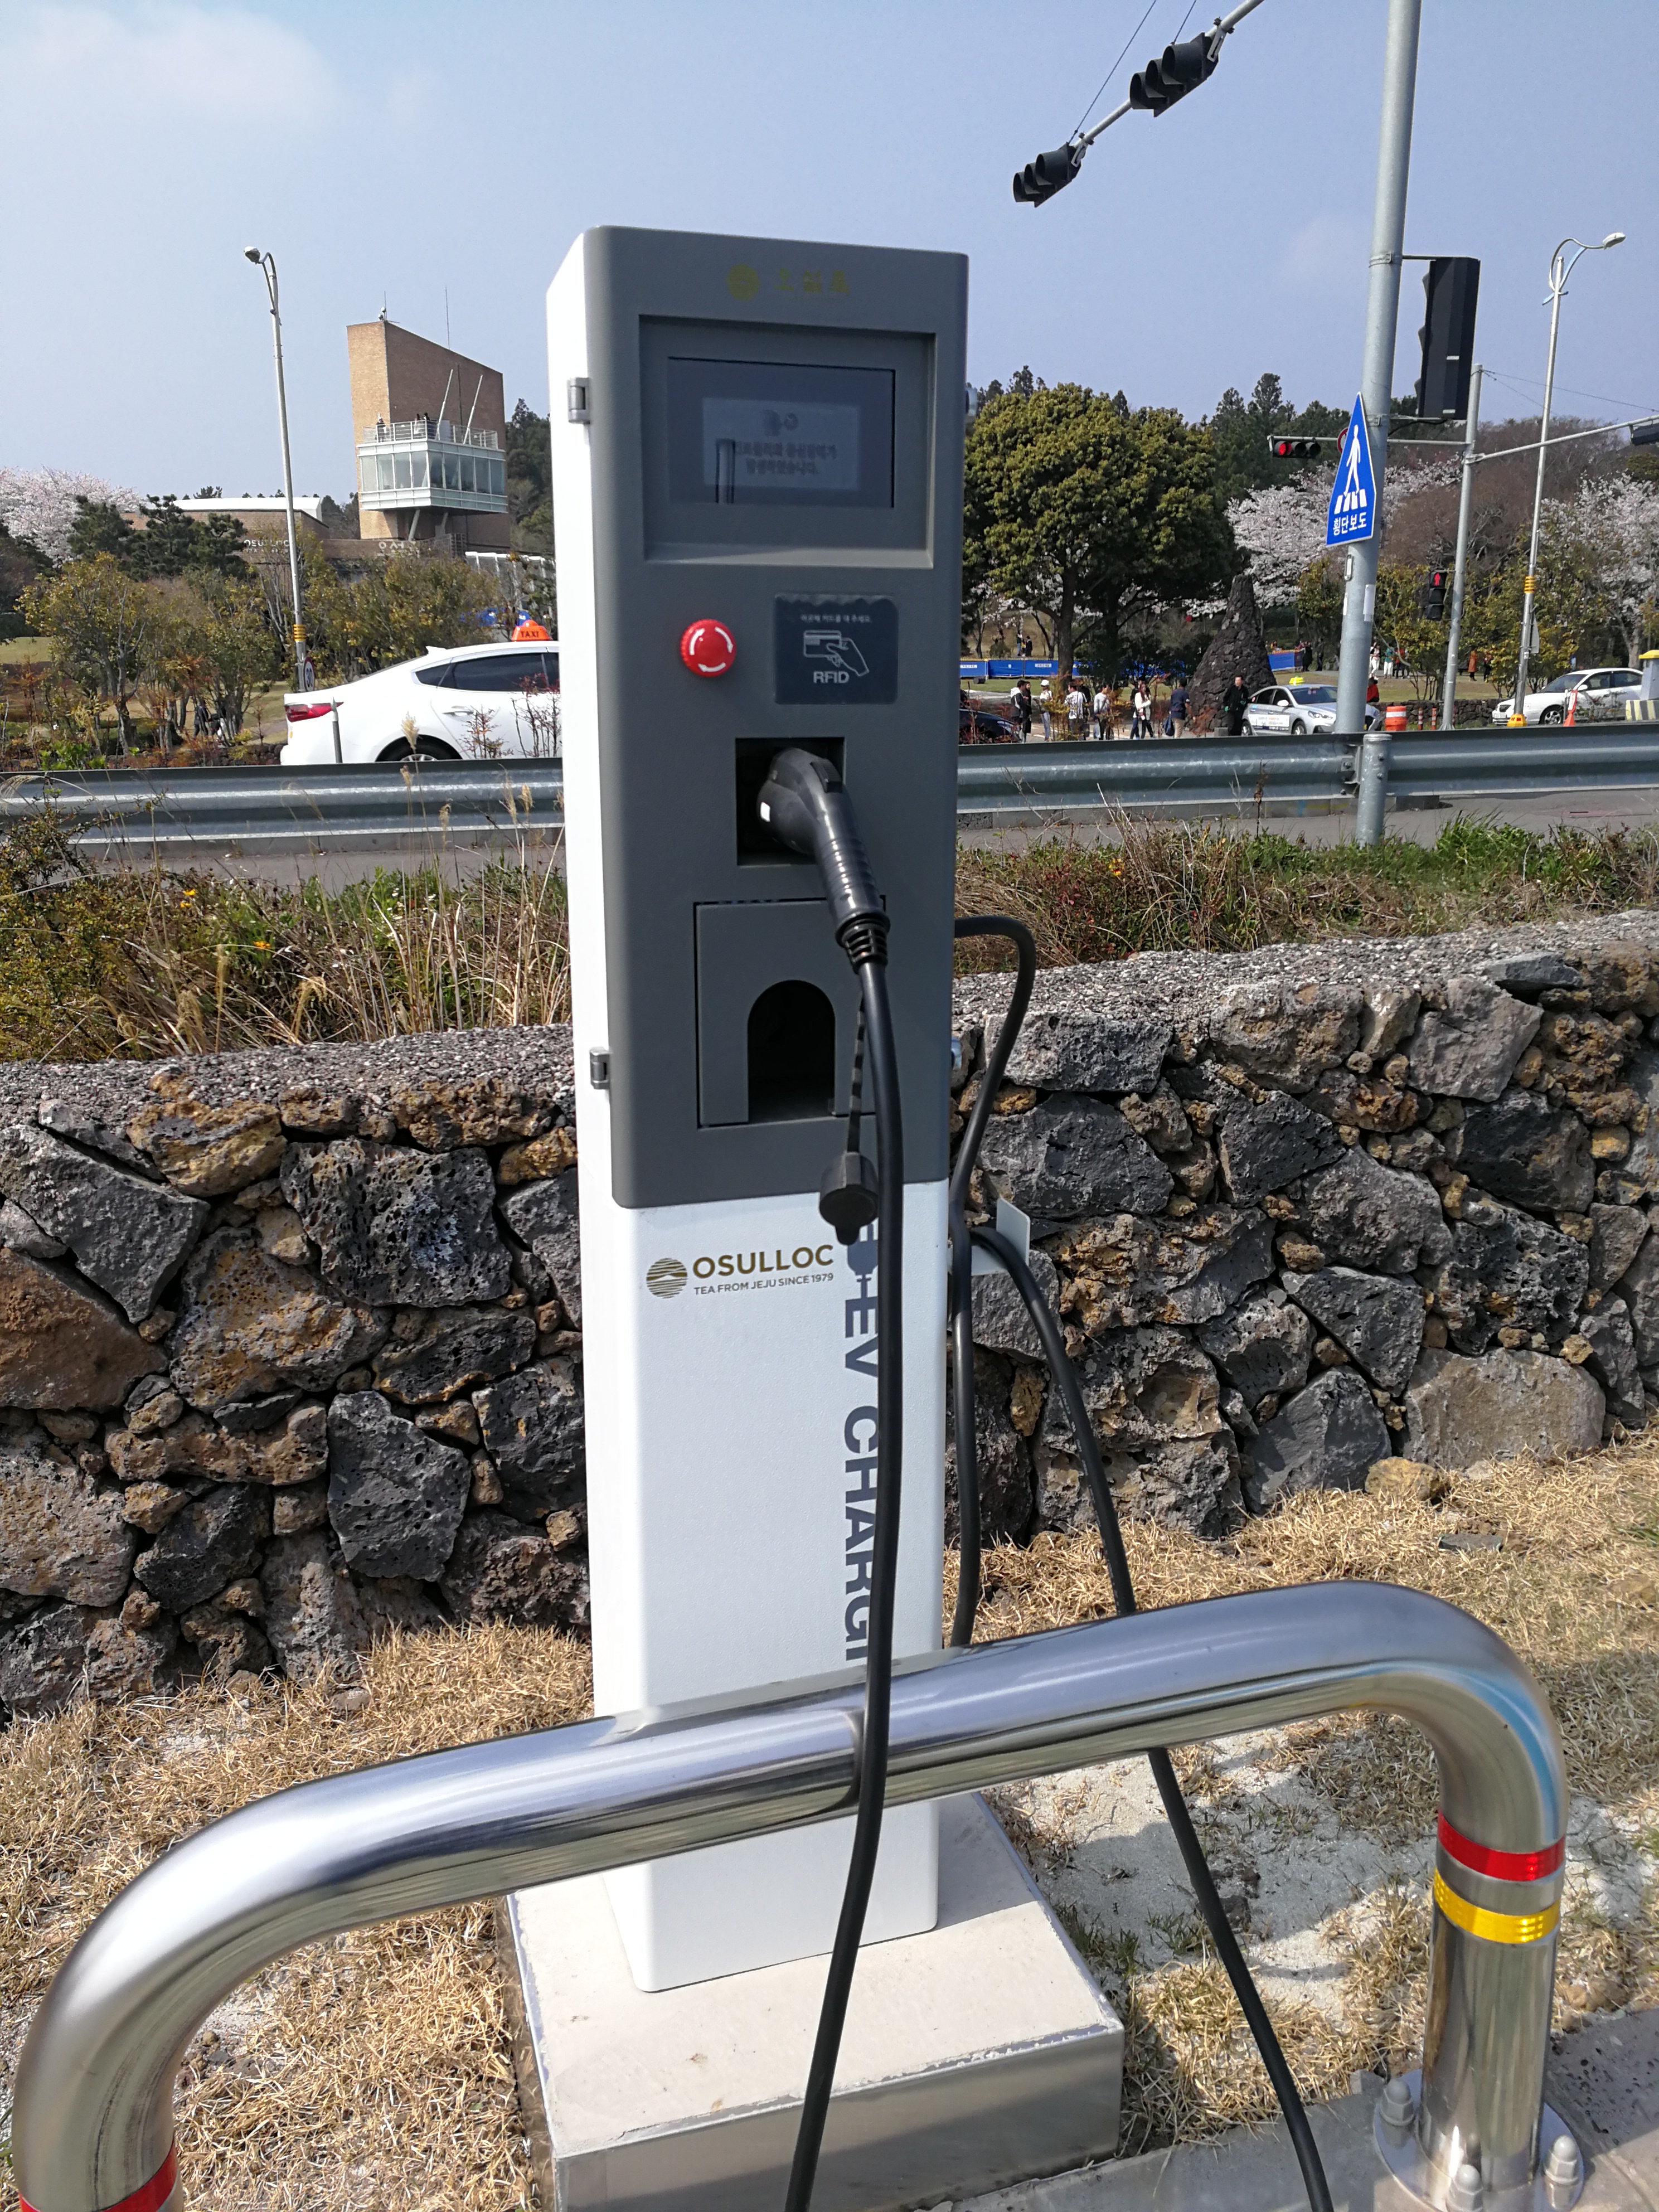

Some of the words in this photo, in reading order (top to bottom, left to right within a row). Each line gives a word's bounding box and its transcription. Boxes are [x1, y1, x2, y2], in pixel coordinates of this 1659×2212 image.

[1333, 512, 1367, 536] 횡단보도
[306, 667, 313, 688] 30
[813, 671, 850, 683] RFID
[692, 1244, 834, 1279] OSULLOC
[693, 1285, 715, 1295] TEA
[717, 1282, 749, 1293] FROM
[750, 1279, 776, 1289] JEJU
[778, 1275, 809, 1287] SINCE
[811, 1273, 834, 1283] 1979
[845, 1296, 879, 1378] EV
